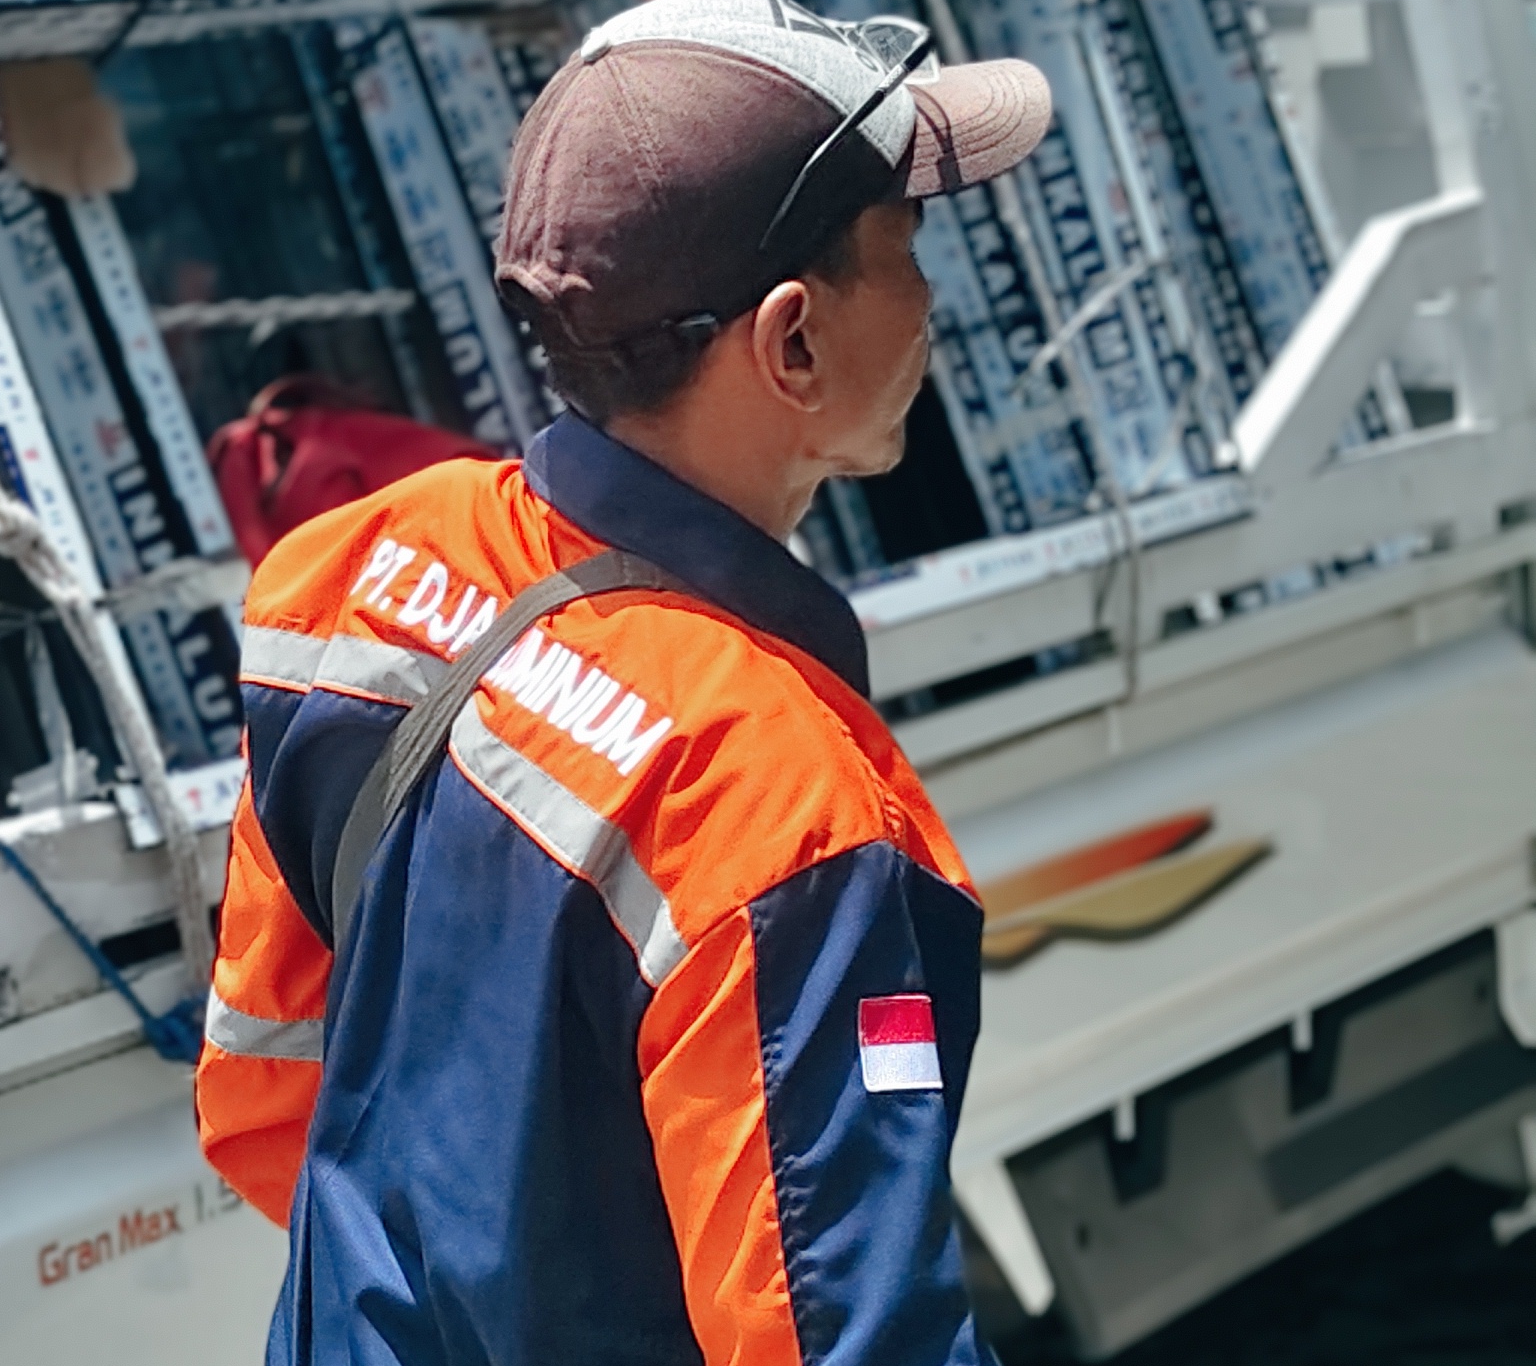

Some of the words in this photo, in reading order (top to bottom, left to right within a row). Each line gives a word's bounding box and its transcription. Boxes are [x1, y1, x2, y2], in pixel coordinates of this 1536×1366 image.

[395, 560, 498, 655] DJA
[483, 626, 674, 777] MINIUM
[37, 1231, 113, 1288] Gran
[118, 1202, 183, 1257] Max
